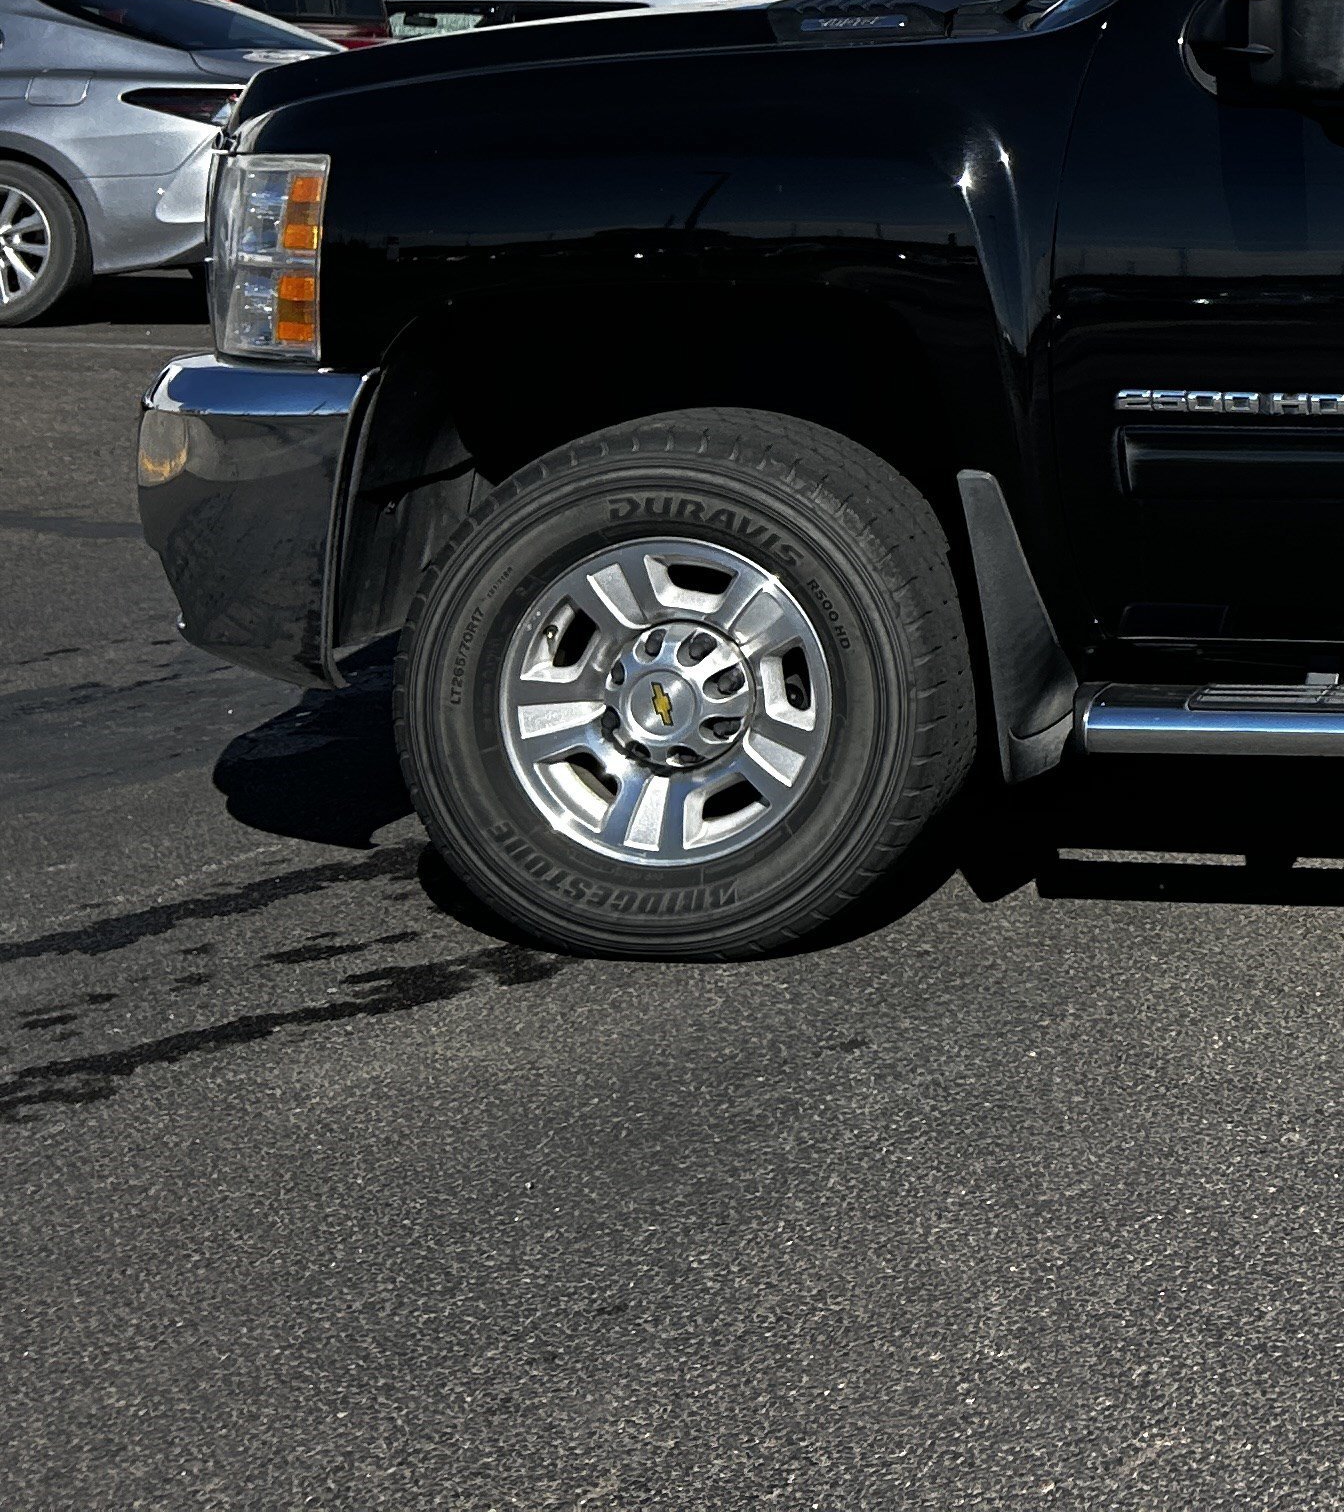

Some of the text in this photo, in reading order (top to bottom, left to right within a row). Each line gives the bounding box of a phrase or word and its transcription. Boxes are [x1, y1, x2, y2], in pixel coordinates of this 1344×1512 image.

[1114, 388, 1260, 414] 2500
[607, 497, 804, 567] DURAVIS
[807, 579, 851, 649] R500 HD
[450, 606, 486, 706] LT265/70R17
